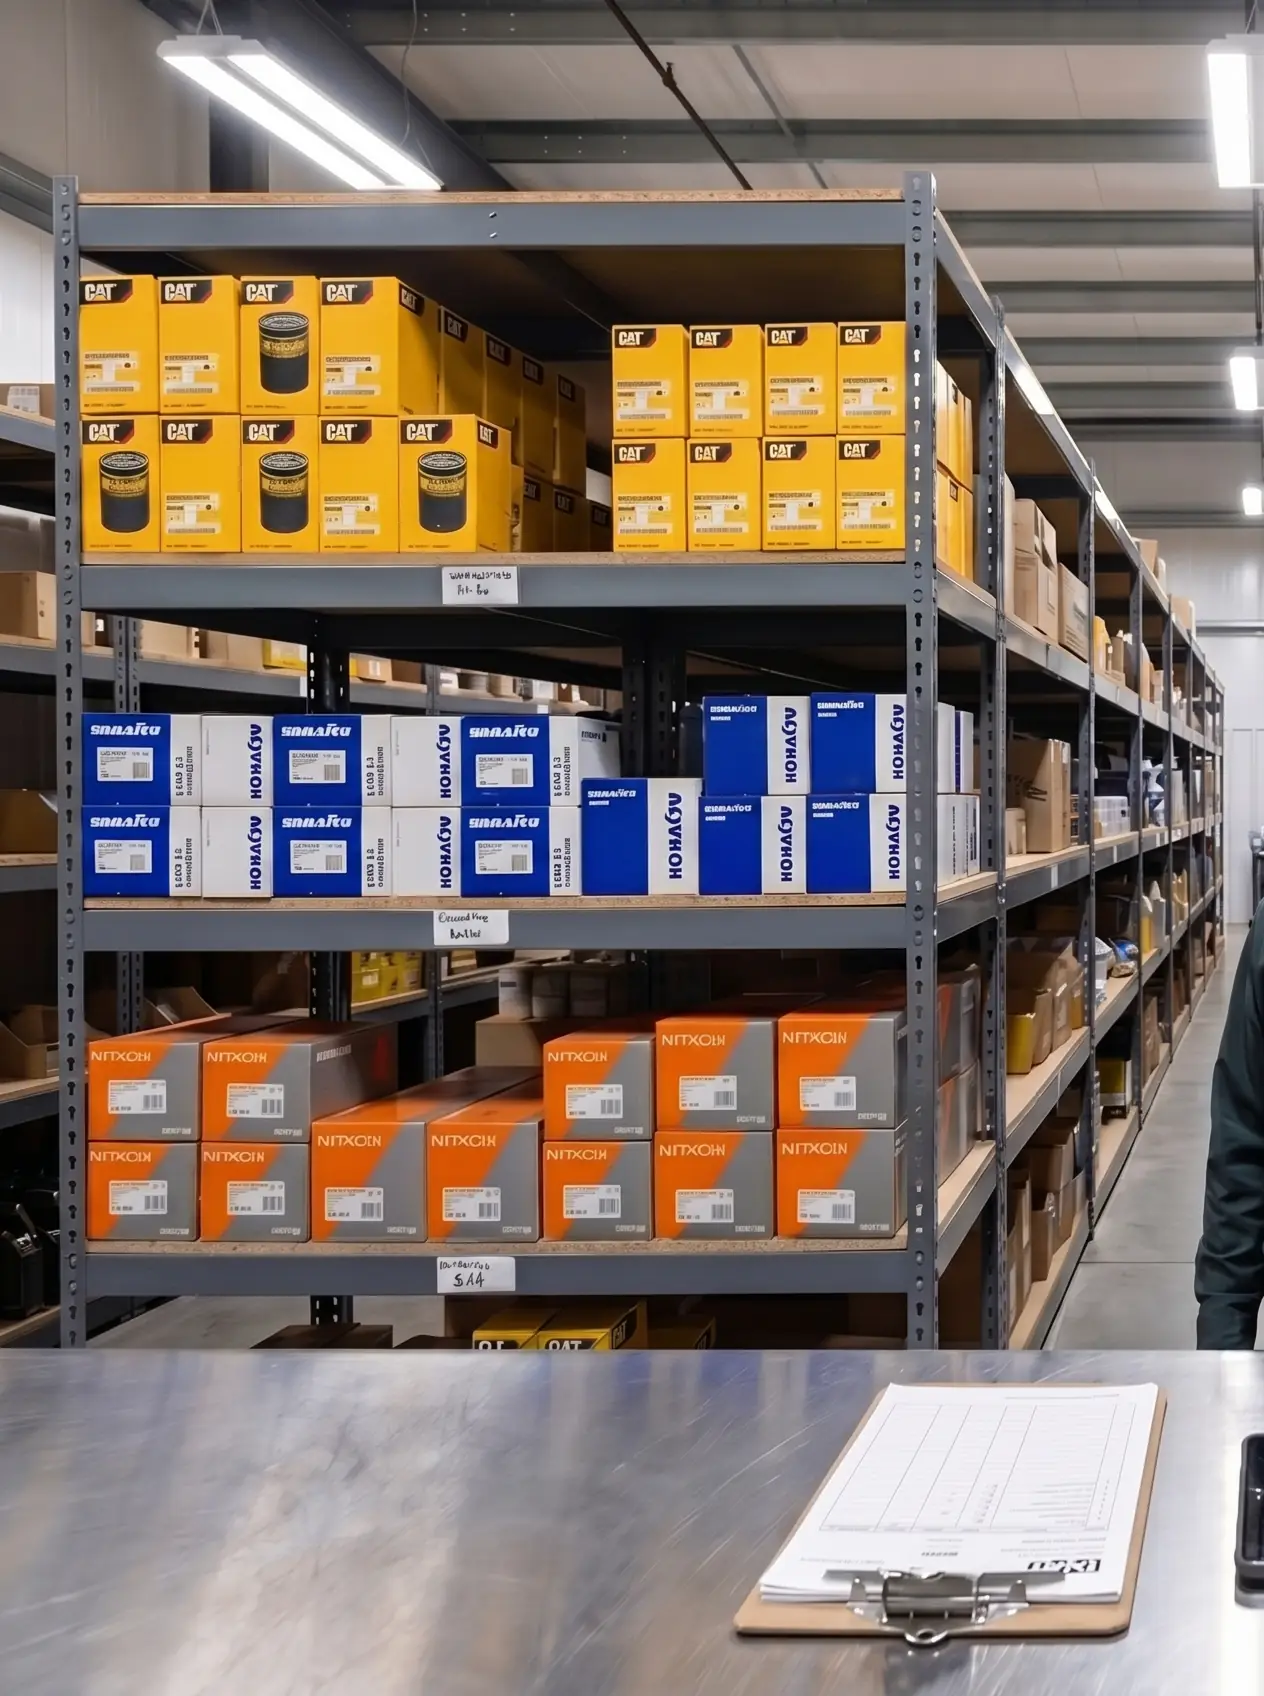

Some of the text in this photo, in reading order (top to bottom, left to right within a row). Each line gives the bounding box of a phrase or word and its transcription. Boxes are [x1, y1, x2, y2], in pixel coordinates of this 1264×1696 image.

[84, 283, 117, 302] CAT
[164, 283, 197, 301] CAT
[245, 283, 279, 302] CAT
[326, 284, 358, 302] CAT
[618, 331, 644, 346] CAT
[695, 331, 721, 346] CAT
[771, 329, 796, 344] CAT
[844, 328, 870, 343] CAT
[88, 423, 120, 443] CAT
[167, 423, 199, 441] CAT
[248, 423, 280, 441] CAT
[326, 423, 358, 441] CAT
[406, 423, 439, 441] CAT
[618, 446, 644, 462] CAT
[694, 445, 720, 461] CAT
[769, 443, 794, 459] CAT
[843, 443, 869, 458] CAT
